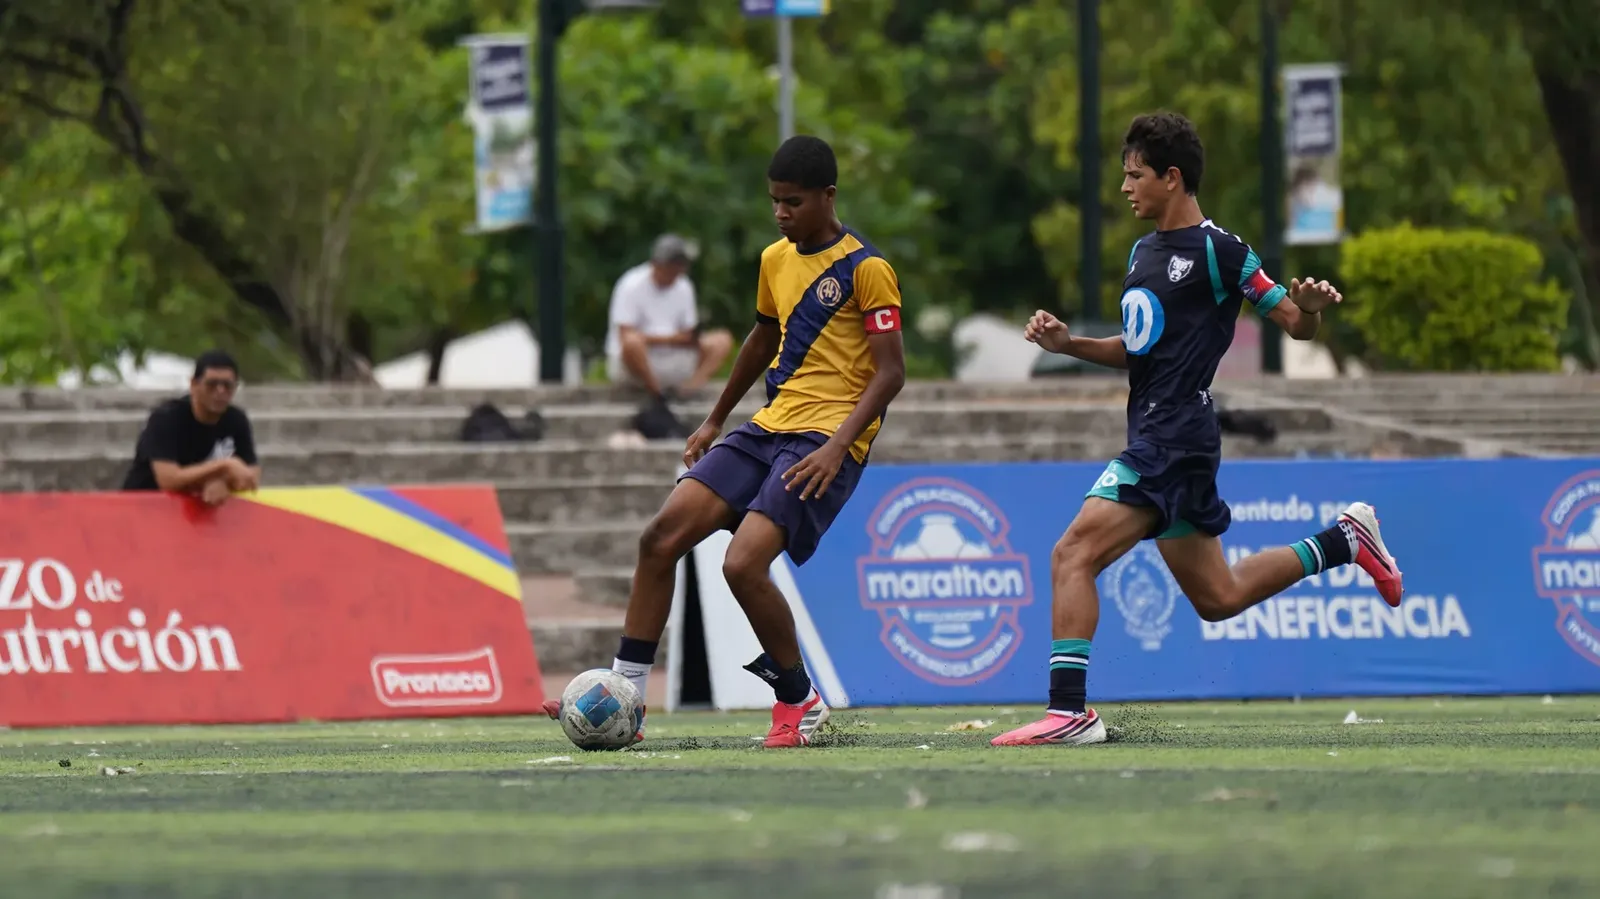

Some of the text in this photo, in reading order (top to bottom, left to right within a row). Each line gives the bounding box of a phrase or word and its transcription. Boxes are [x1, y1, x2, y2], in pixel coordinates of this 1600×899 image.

[875, 309, 894, 330] C
[1230, 495, 1314, 522] entado
[83, 568, 125, 603] de
[866, 564, 1025, 600] marathon
[1202, 595, 1471, 641] BENEFICENCIA
[381, 668, 492, 695] Pronaca
